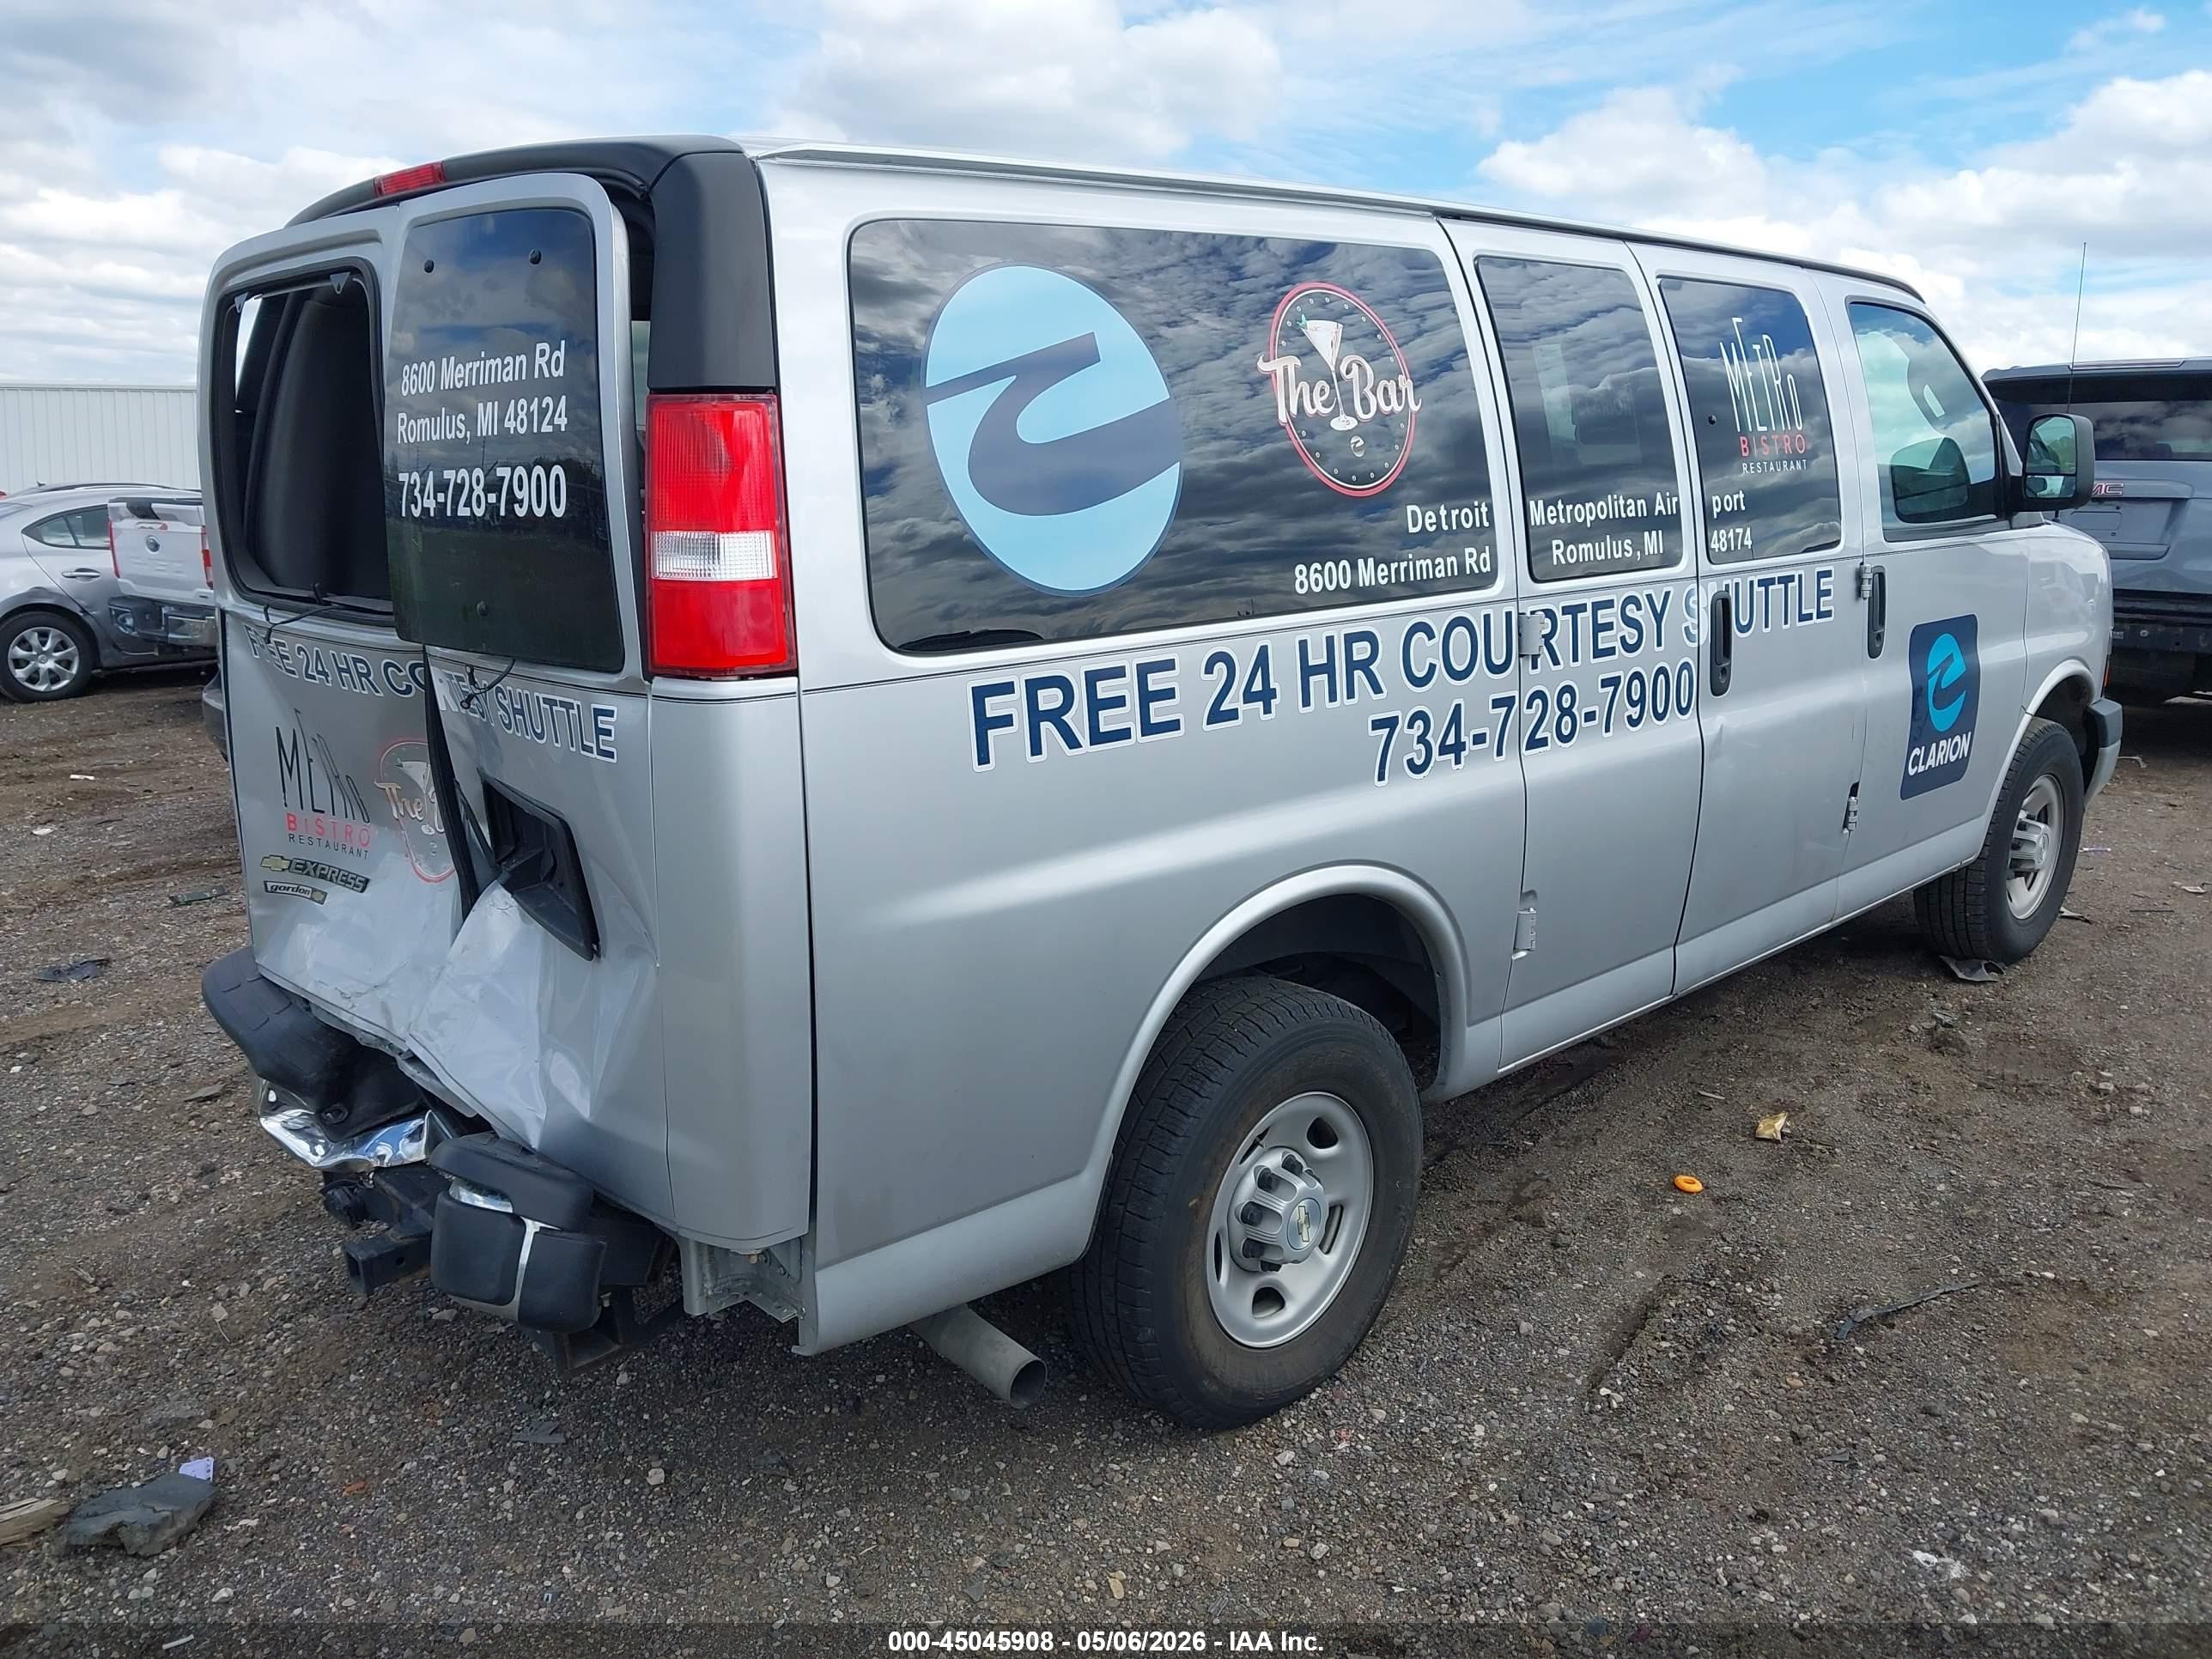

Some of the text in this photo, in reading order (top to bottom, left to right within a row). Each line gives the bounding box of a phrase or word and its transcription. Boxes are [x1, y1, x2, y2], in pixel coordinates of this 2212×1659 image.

[401, 339, 566, 397] 8600 Merriman Rd
[1257, 354, 1422, 427] The Bar
[1719, 317, 1802, 432] METRO
[398, 395, 568, 445] Romulus, MI 48124
[1740, 434, 1806, 457] BISTRO
[1742, 459, 1808, 474] RESTAURANT
[398, 465, 567, 518] 734-728-7900
[1406, 489, 1746, 533] Detroit Metropolitan Air port
[1294, 560, 1352, 594] 8600
[1358, 553, 1458, 587] Merriman
[1464, 545, 1492, 574] Rd
[1644, 530, 1663, 556] MI
[1711, 527, 1753, 552] 48174
[968, 566, 1834, 772] FREE 24 HR COURTESY SUTTLE
[295, 644, 332, 687] 24
[330, 650, 384, 696] HR
[494, 684, 617, 763] SHUTTLE
[1368, 657, 1696, 787] 734-728-7900
[1908, 731, 1972, 776] CLARION
[374, 780, 424, 822] The
[286, 812, 371, 847] BISTRO
[289, 833, 369, 860] RESTAURANT
[270, 883, 311, 896] gordon
[289, 859, 367, 892] EXPRESS
